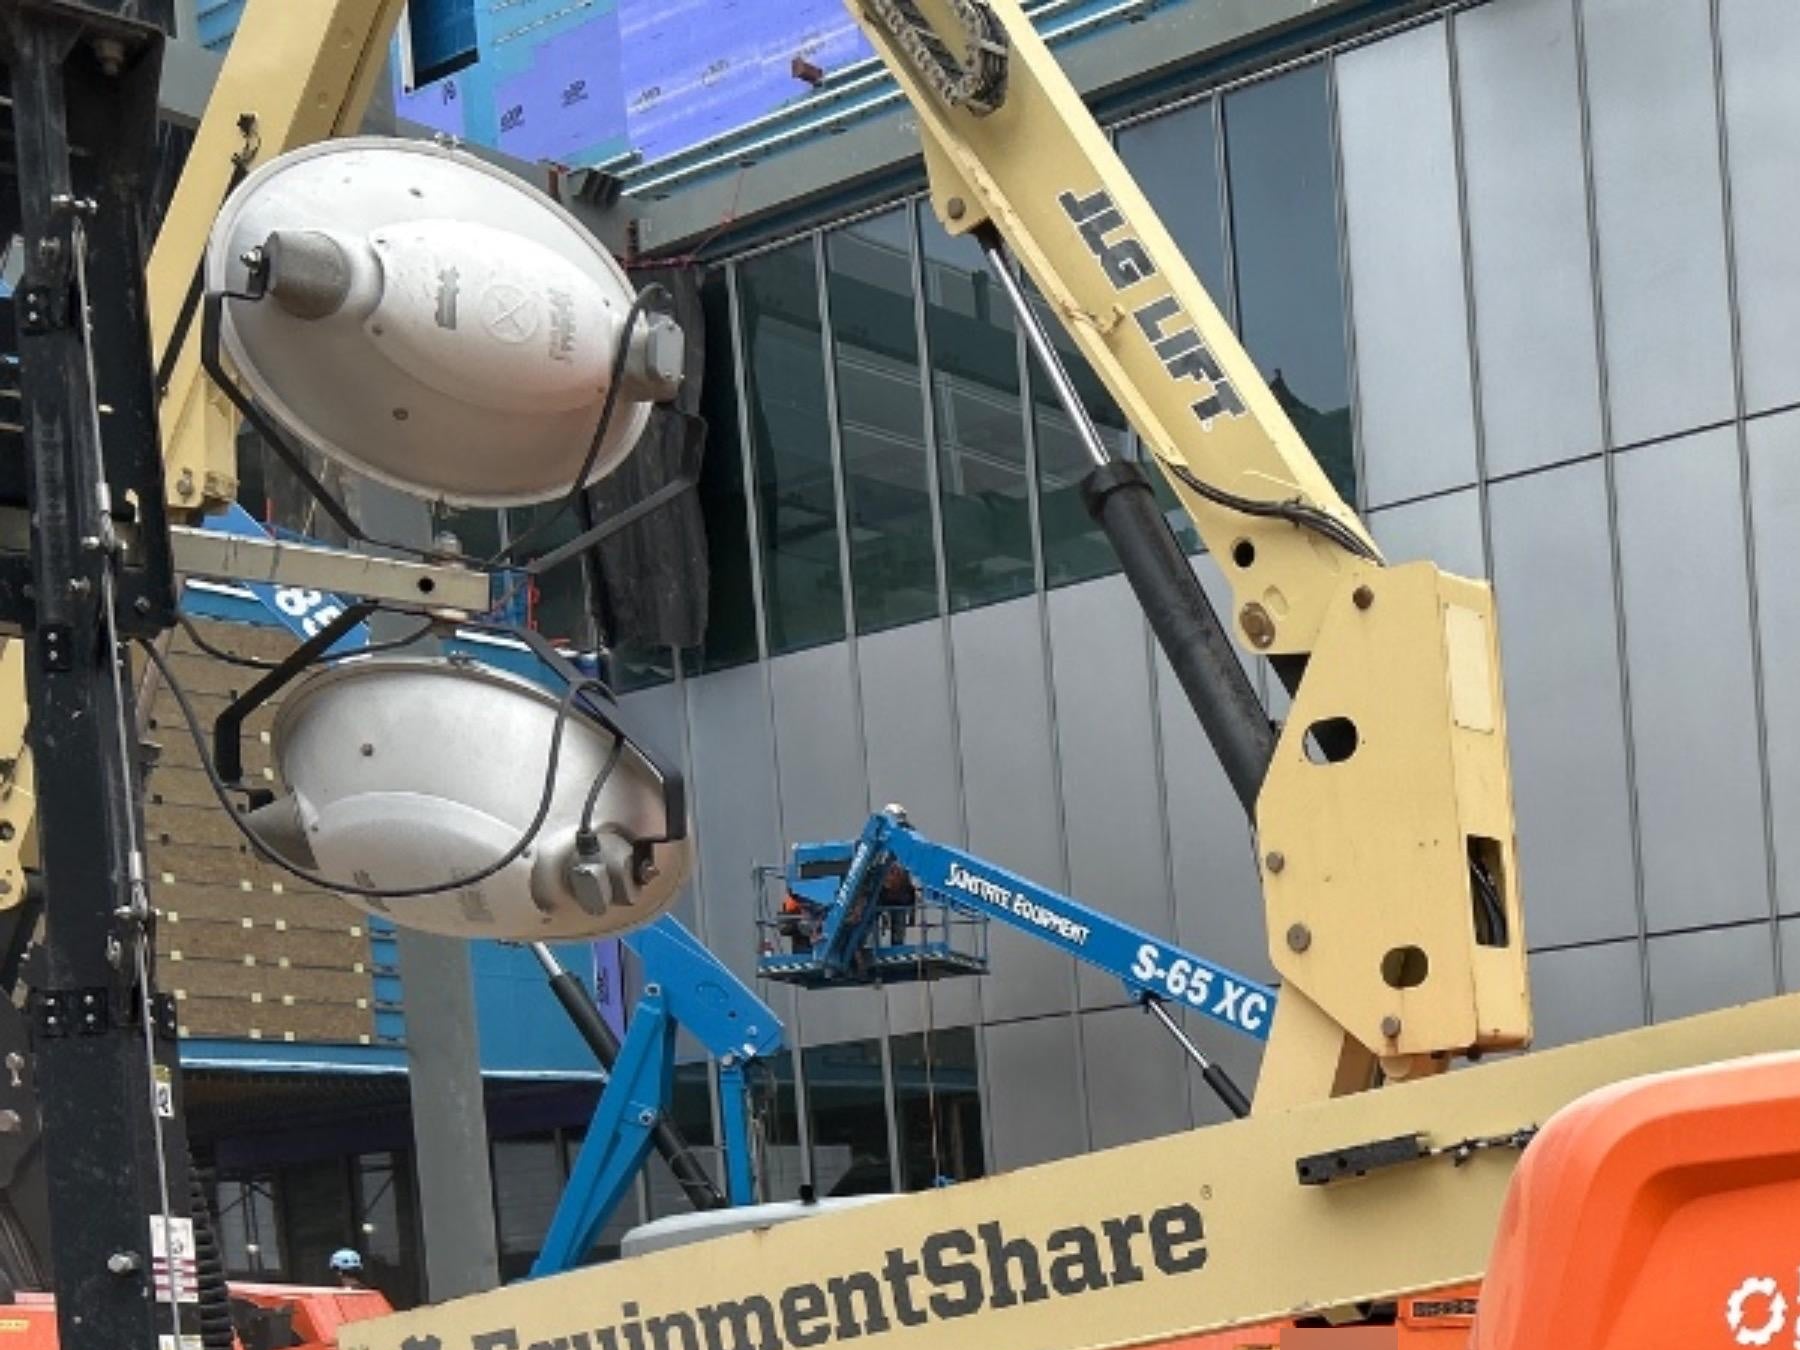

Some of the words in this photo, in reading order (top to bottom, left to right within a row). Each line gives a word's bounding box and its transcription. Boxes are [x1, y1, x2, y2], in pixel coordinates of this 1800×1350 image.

[1058, 189, 1157, 293] JLG
[1133, 293, 1247, 421] LIFT
[1130, 943, 1214, 1006] S-65
[1211, 979, 1267, 1030] XC
